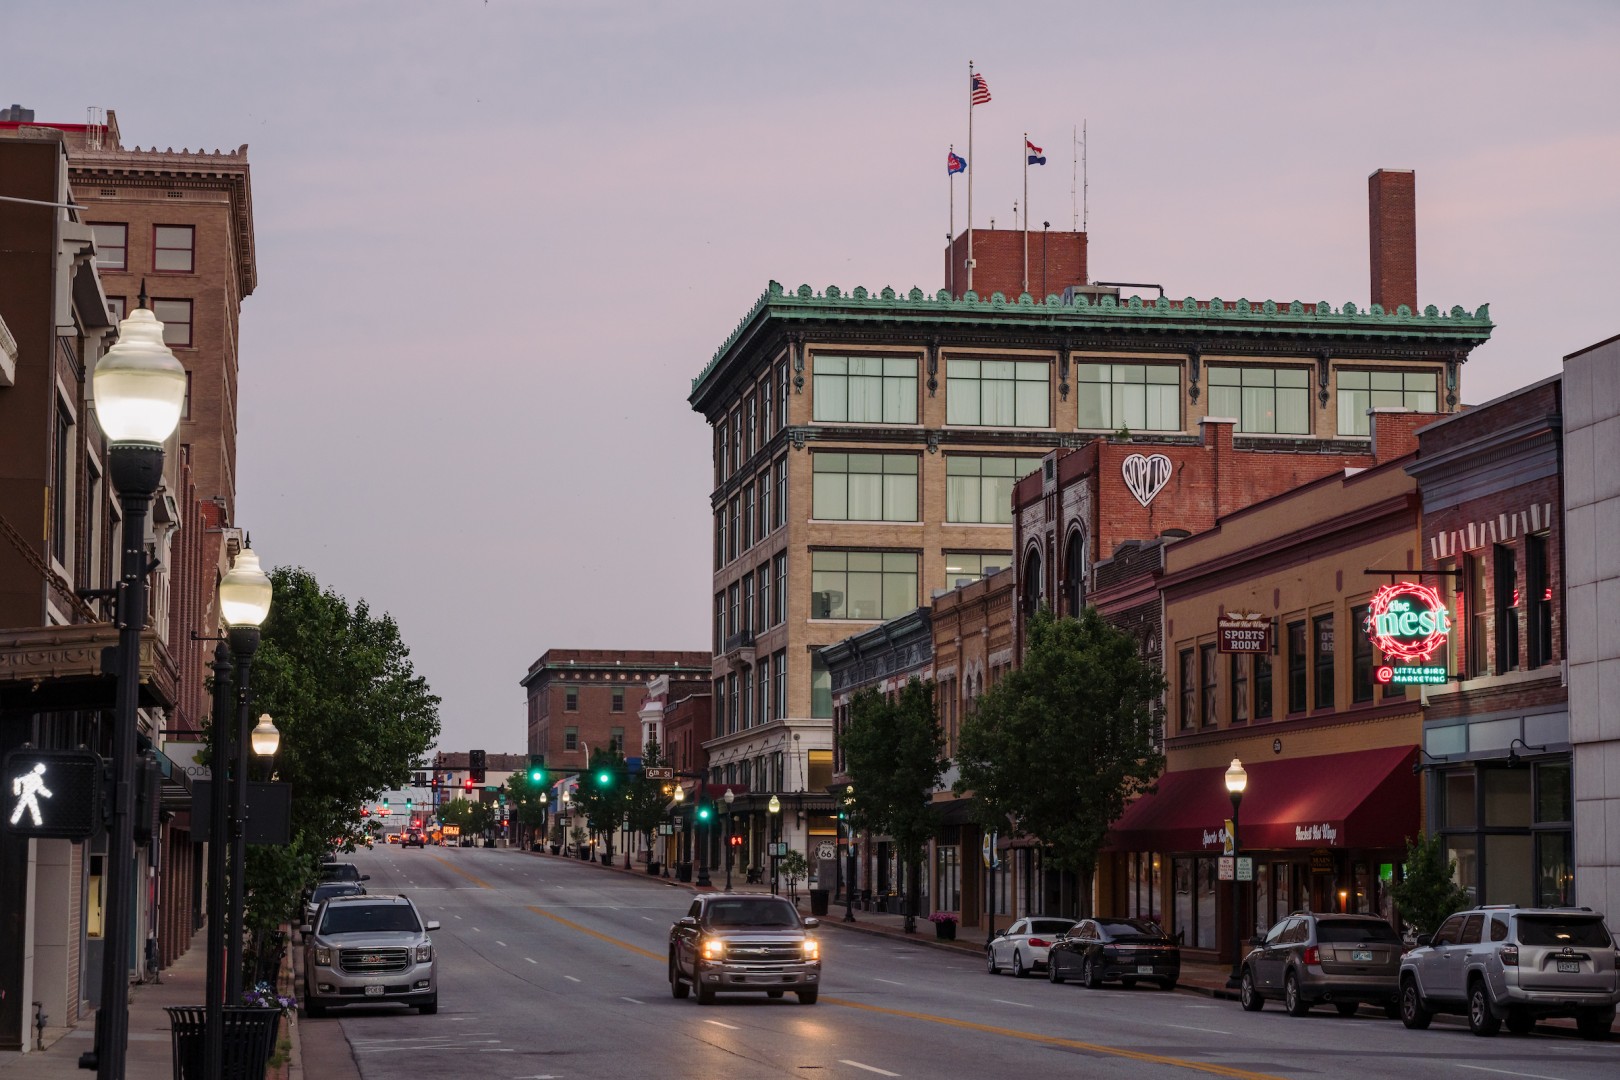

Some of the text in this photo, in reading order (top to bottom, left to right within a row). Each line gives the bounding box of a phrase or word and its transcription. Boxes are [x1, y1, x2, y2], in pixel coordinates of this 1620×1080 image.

[1126, 457, 1170, 502] JOPLIN
[1388, 600, 1410, 612] the
[1240, 620, 1252, 628] Hot
[1252, 621, 1270, 630] Wings
[1375, 606, 1451, 636] nest
[1224, 630, 1265, 640] SPORTS
[1231, 640, 1261, 650] ROOM
[1377, 667, 1393, 682] @
[1393, 667, 1446, 675] LITTLE BIRD
[1393, 675, 1446, 683] MARKETING
[648, 769, 671, 778] 6th St
[1312, 824, 1322, 840] Hot
[1322, 823, 1337, 845] Wings
[820, 850, 832, 858] 66
